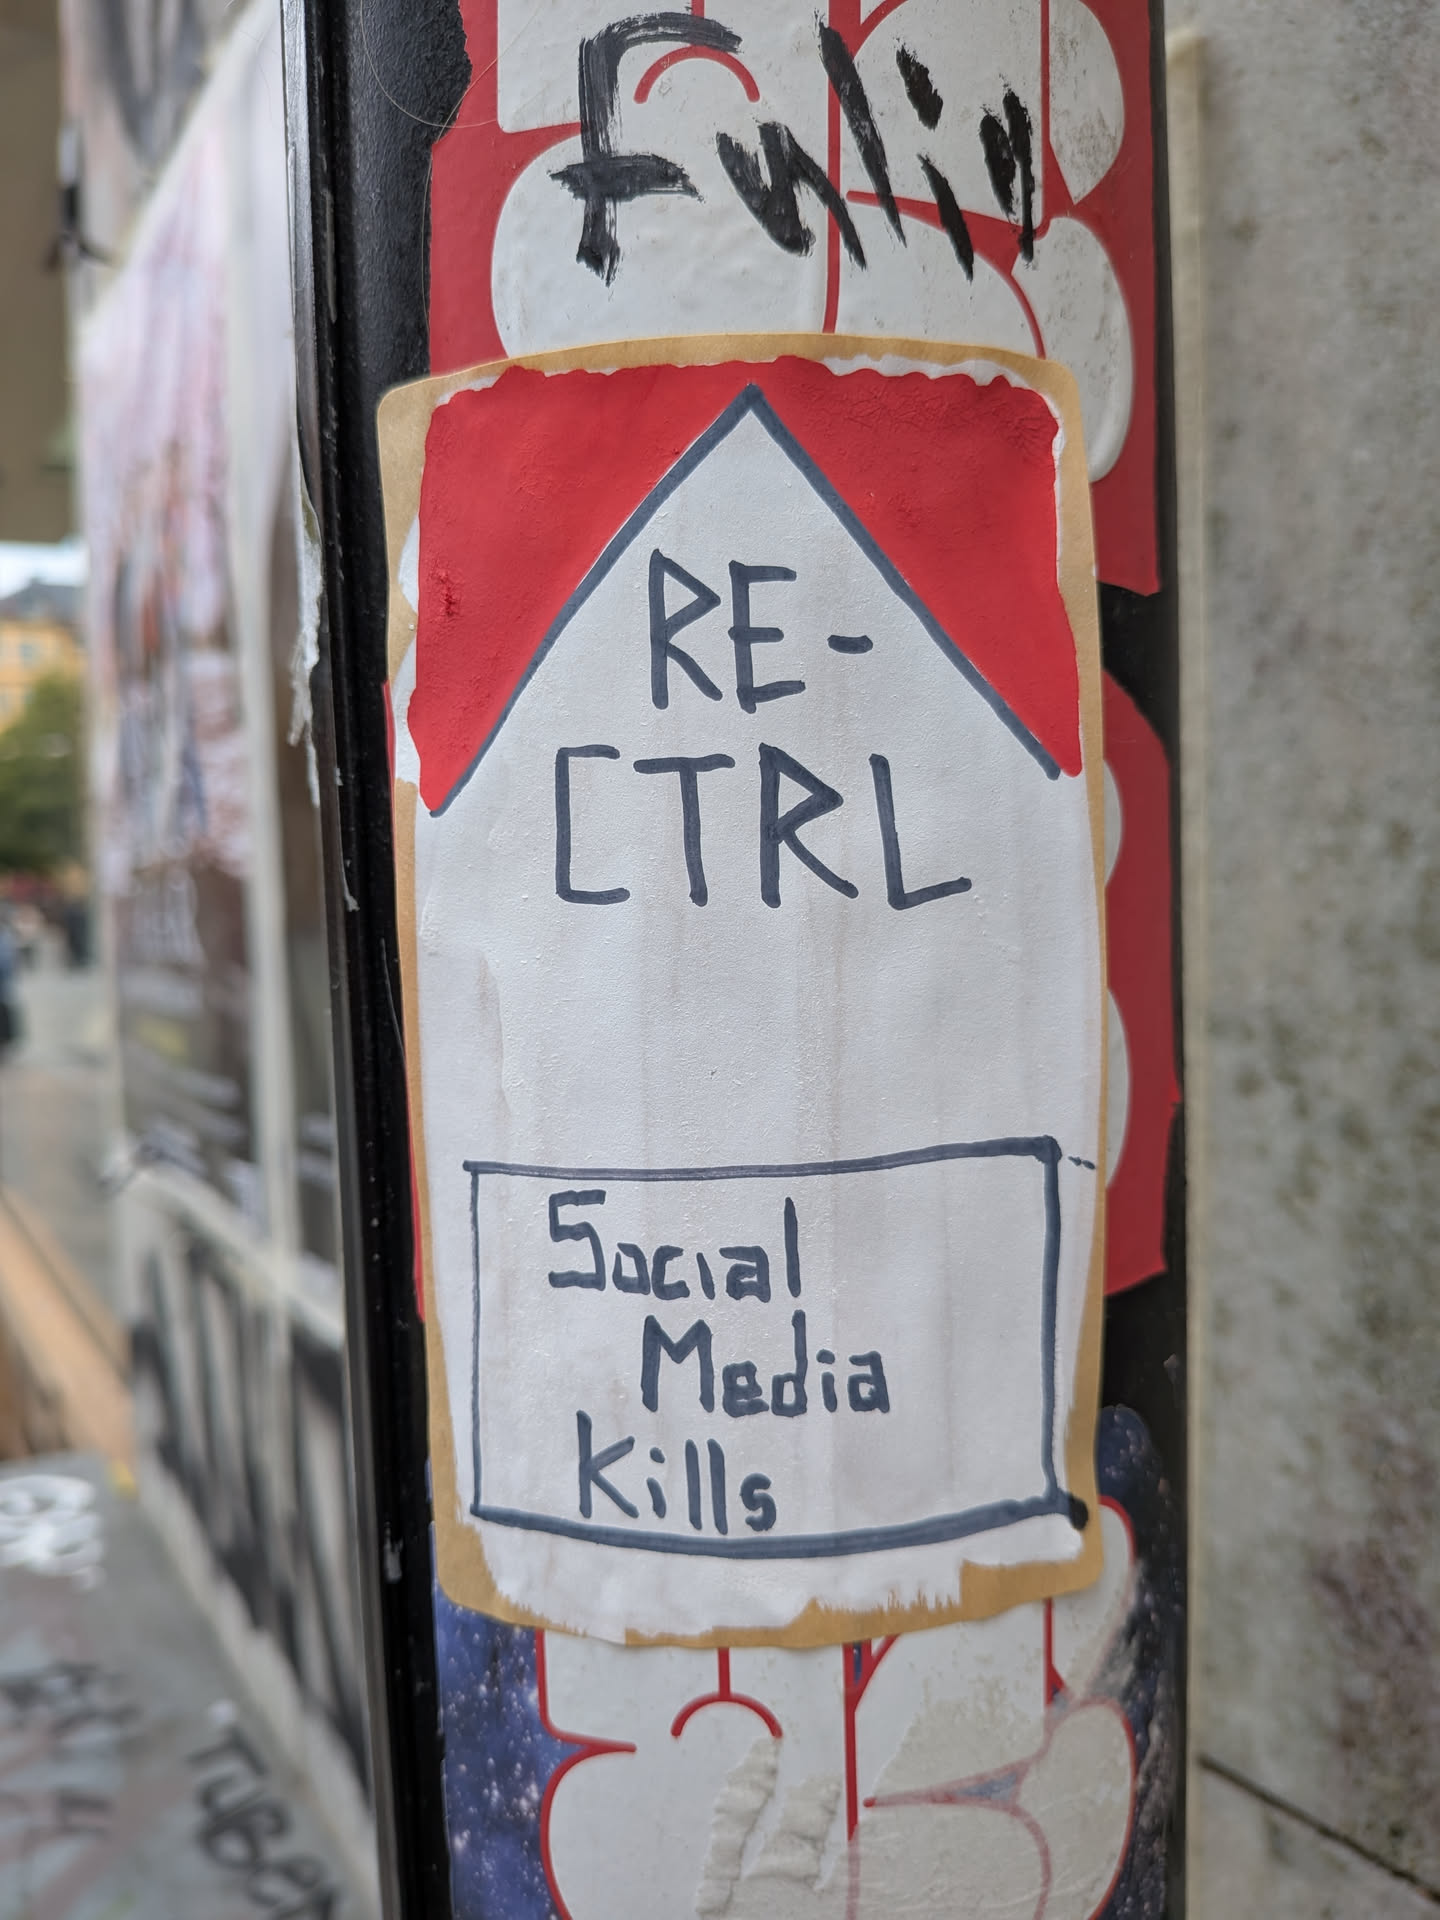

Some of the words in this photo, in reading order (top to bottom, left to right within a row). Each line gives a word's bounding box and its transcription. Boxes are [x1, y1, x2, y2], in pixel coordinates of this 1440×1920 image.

[649, 548, 873, 714] RE-
[555, 743, 972, 910] CTRL
[549, 1190, 801, 1303] Social
[641, 1310, 890, 1418] Media
[577, 1411, 777, 1535] Kills
